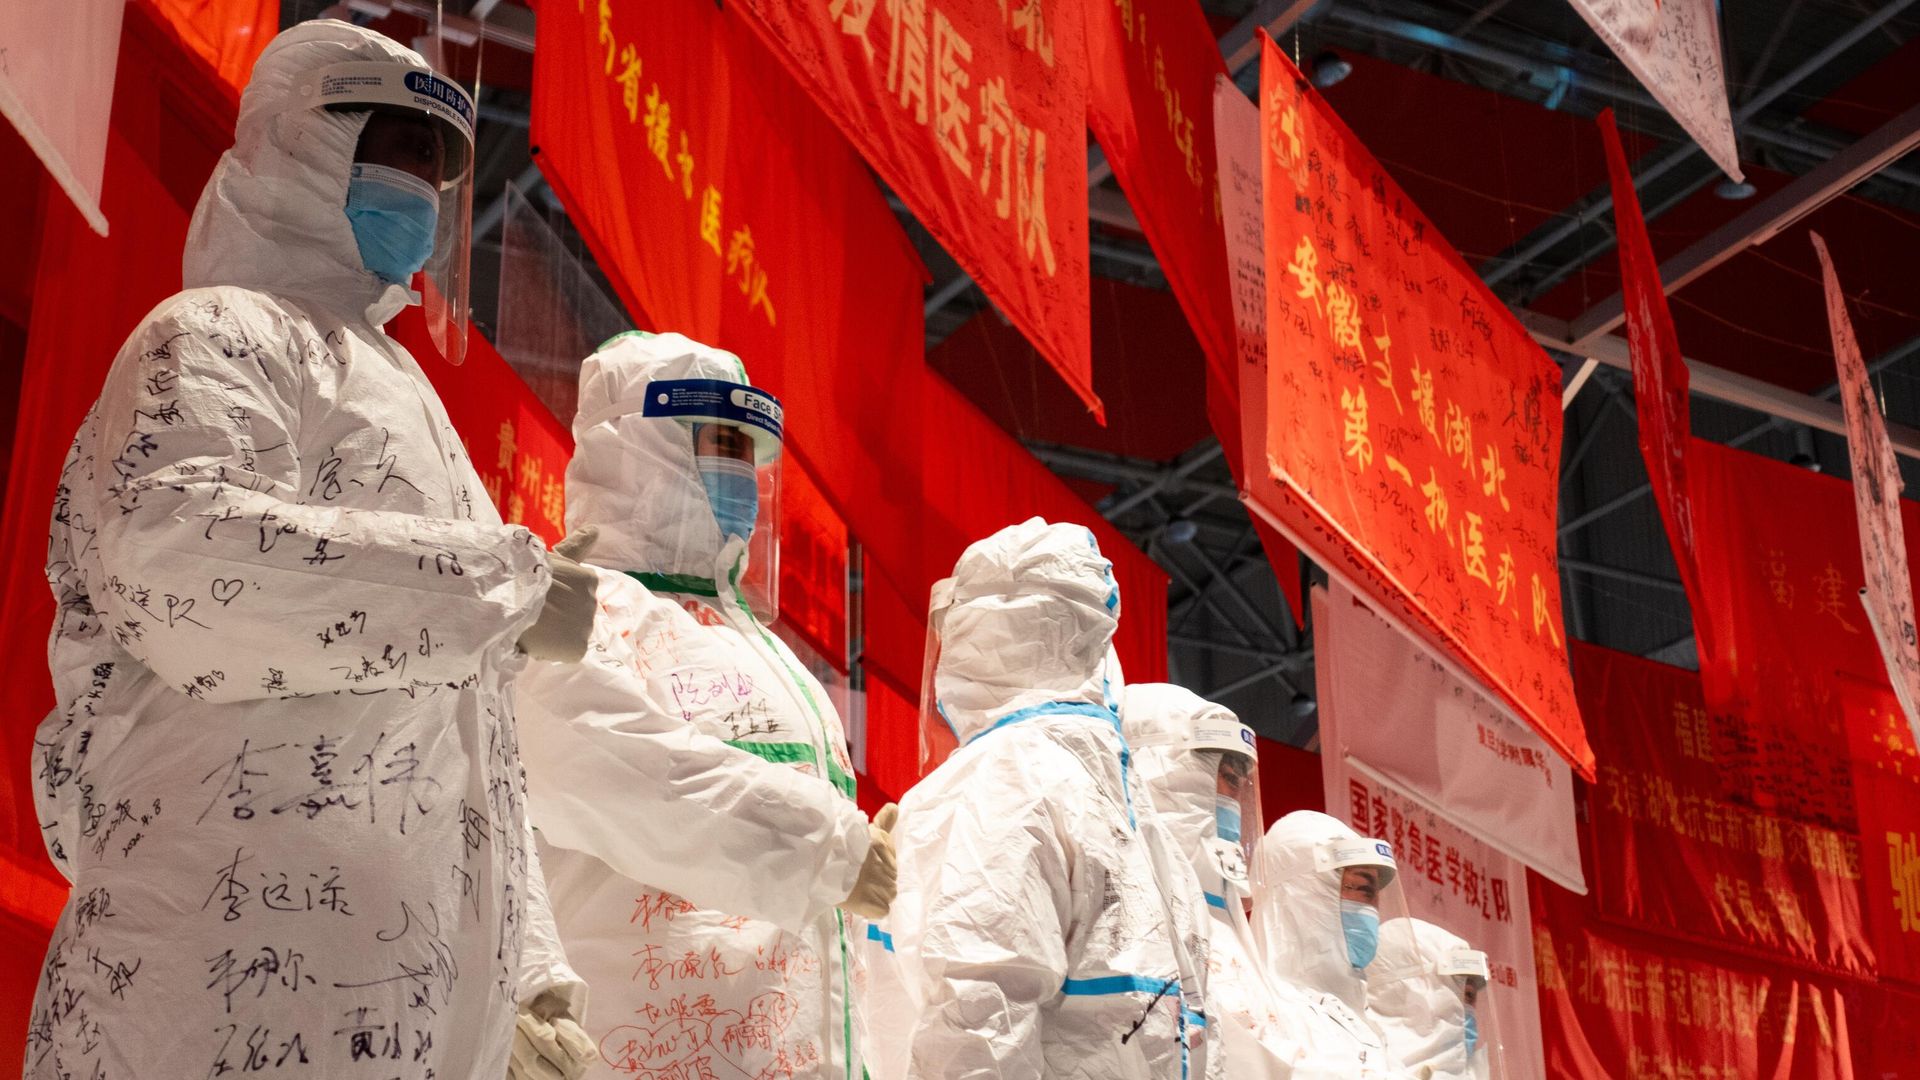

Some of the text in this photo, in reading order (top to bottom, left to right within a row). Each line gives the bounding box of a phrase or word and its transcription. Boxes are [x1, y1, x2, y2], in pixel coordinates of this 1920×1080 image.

[744, 393, 772, 415] Face
[1340, 382, 1561, 649] 第一批医疗队
